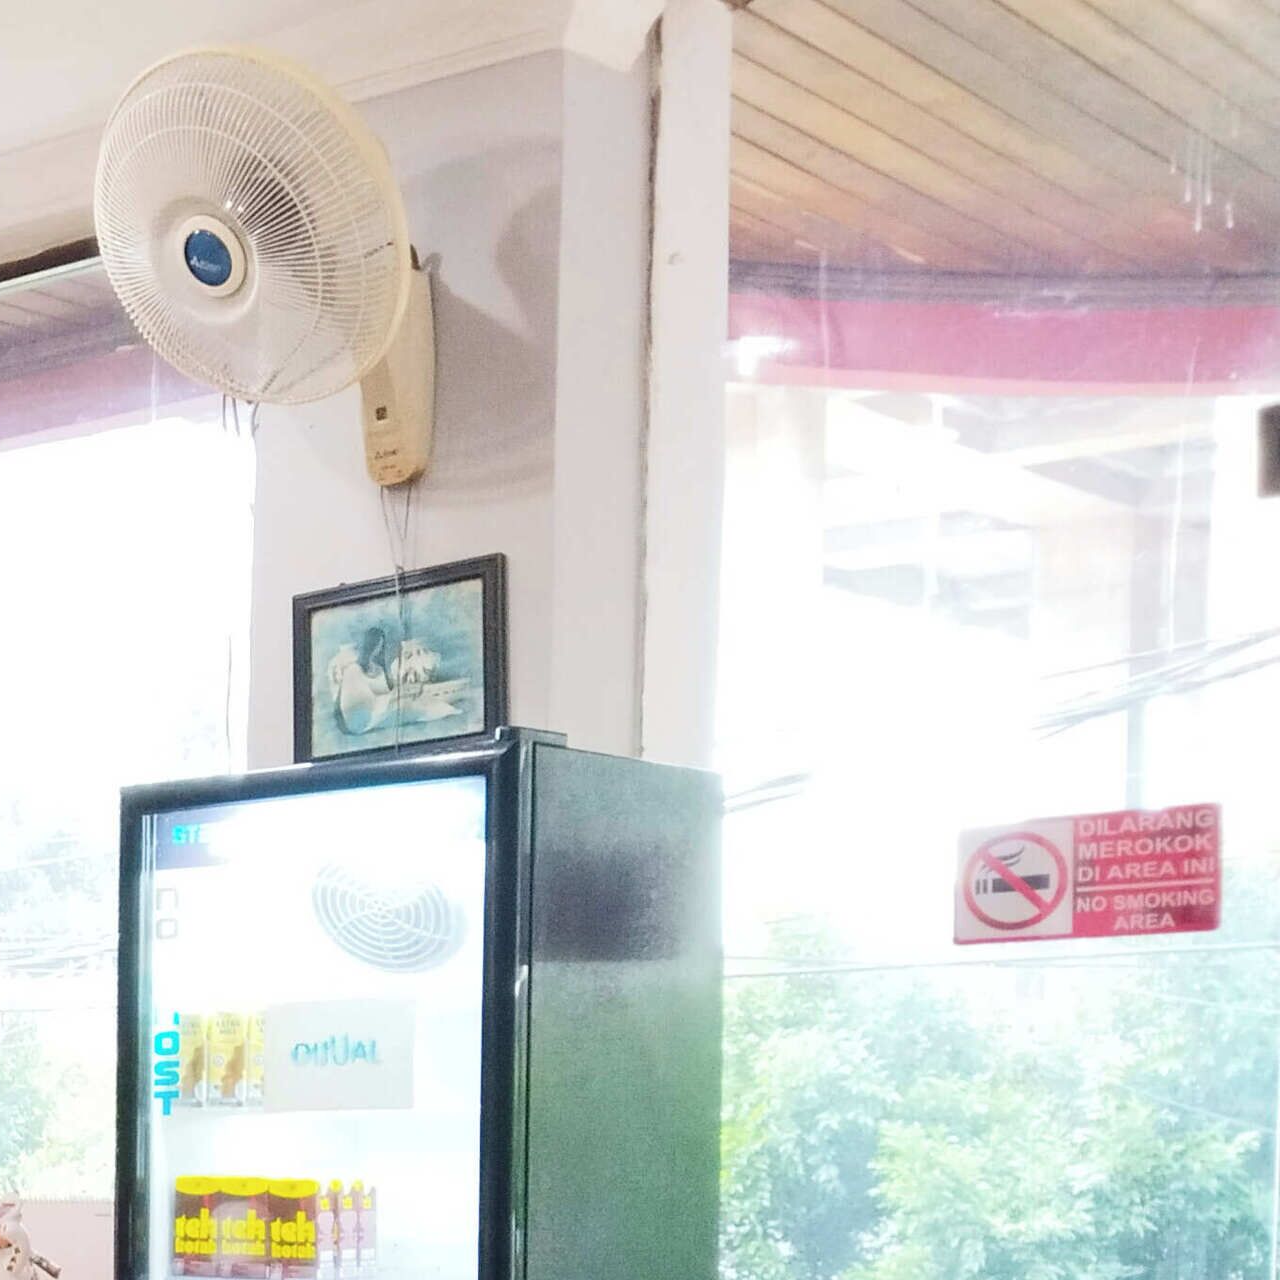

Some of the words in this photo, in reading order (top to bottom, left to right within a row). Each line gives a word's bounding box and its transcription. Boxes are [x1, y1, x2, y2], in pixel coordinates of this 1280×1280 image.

[1078, 808, 1215, 837] DILARANG
[1078, 833, 1214, 861] MEROKOK
[1077, 866, 1101, 883] DI
[1107, 860, 1176, 880] AREA
[1183, 856, 1215, 874] INI
[1076, 896, 1107, 913] NO
[1113, 889, 1216, 911] SMOKING
[1113, 912, 1176, 931] AREA
